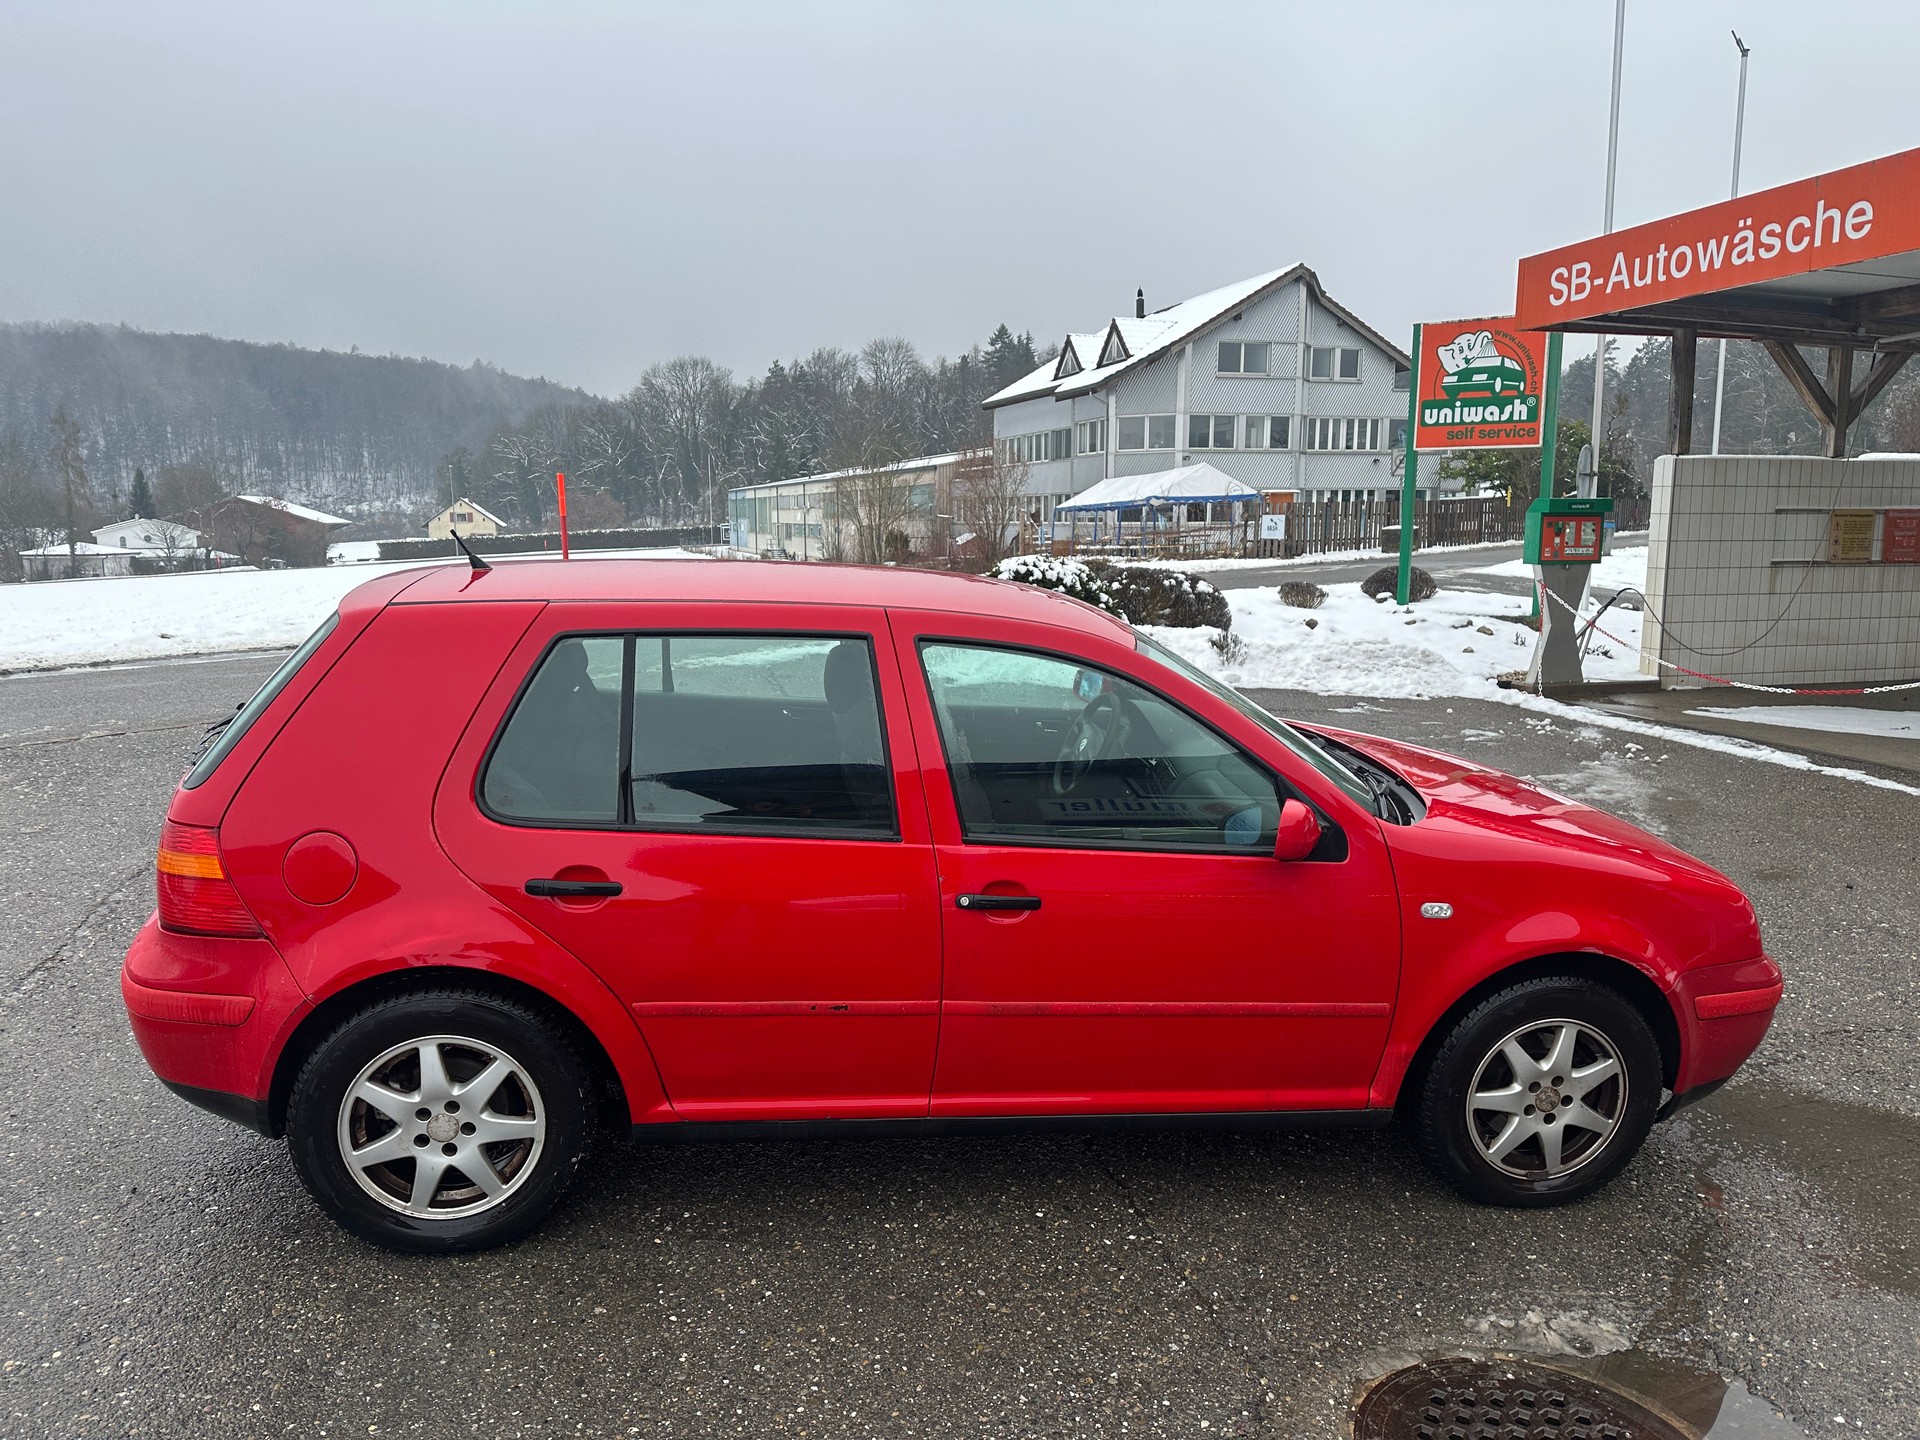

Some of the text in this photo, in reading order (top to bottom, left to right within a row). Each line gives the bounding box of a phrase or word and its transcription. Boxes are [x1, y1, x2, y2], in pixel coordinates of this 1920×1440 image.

[1549, 200, 1874, 306] SB-Autowäsche
[1495, 329, 1539, 393] www.uniwash.ch
[1424, 399, 1528, 425] uniwash
[1446, 425, 1536, 440] self service
